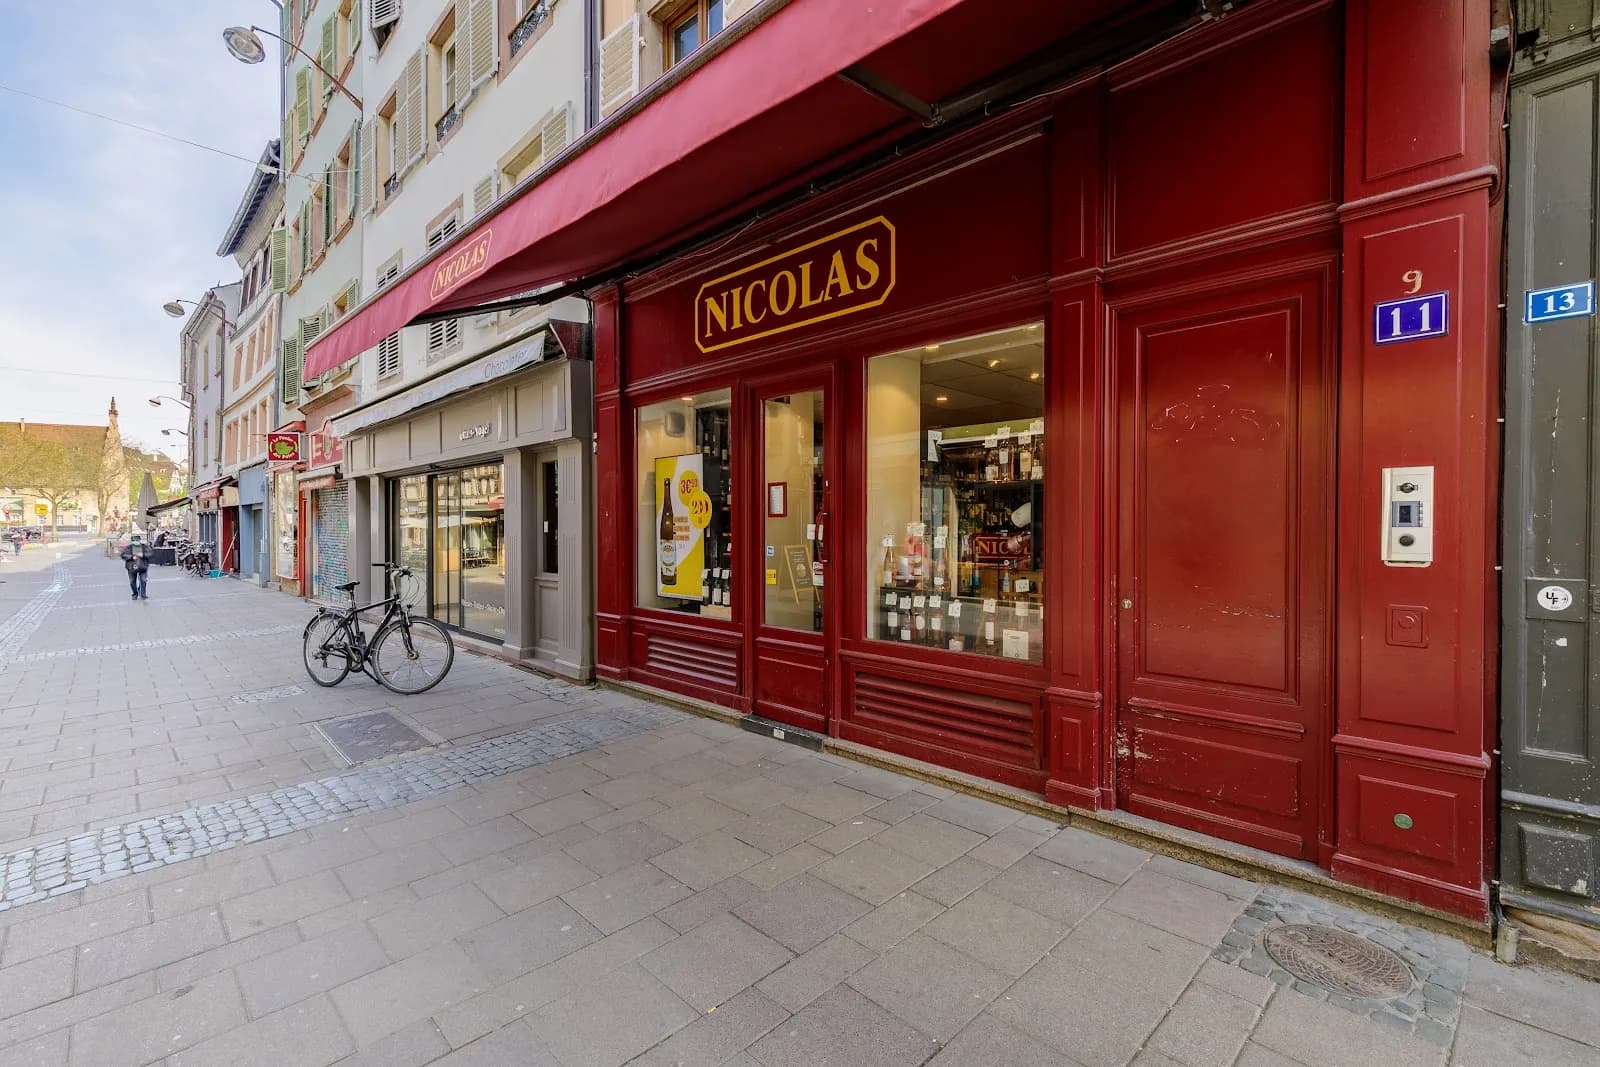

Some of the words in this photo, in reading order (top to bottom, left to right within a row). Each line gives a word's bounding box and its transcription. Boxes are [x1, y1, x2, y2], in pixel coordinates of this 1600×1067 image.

[434, 239, 487, 291] NICOLAS
[1401, 269, 1423, 294] 9
[704, 237, 880, 338] NICOLAS
[1543, 291, 1575, 314] 13
[1390, 301, 1431, 337] 11
